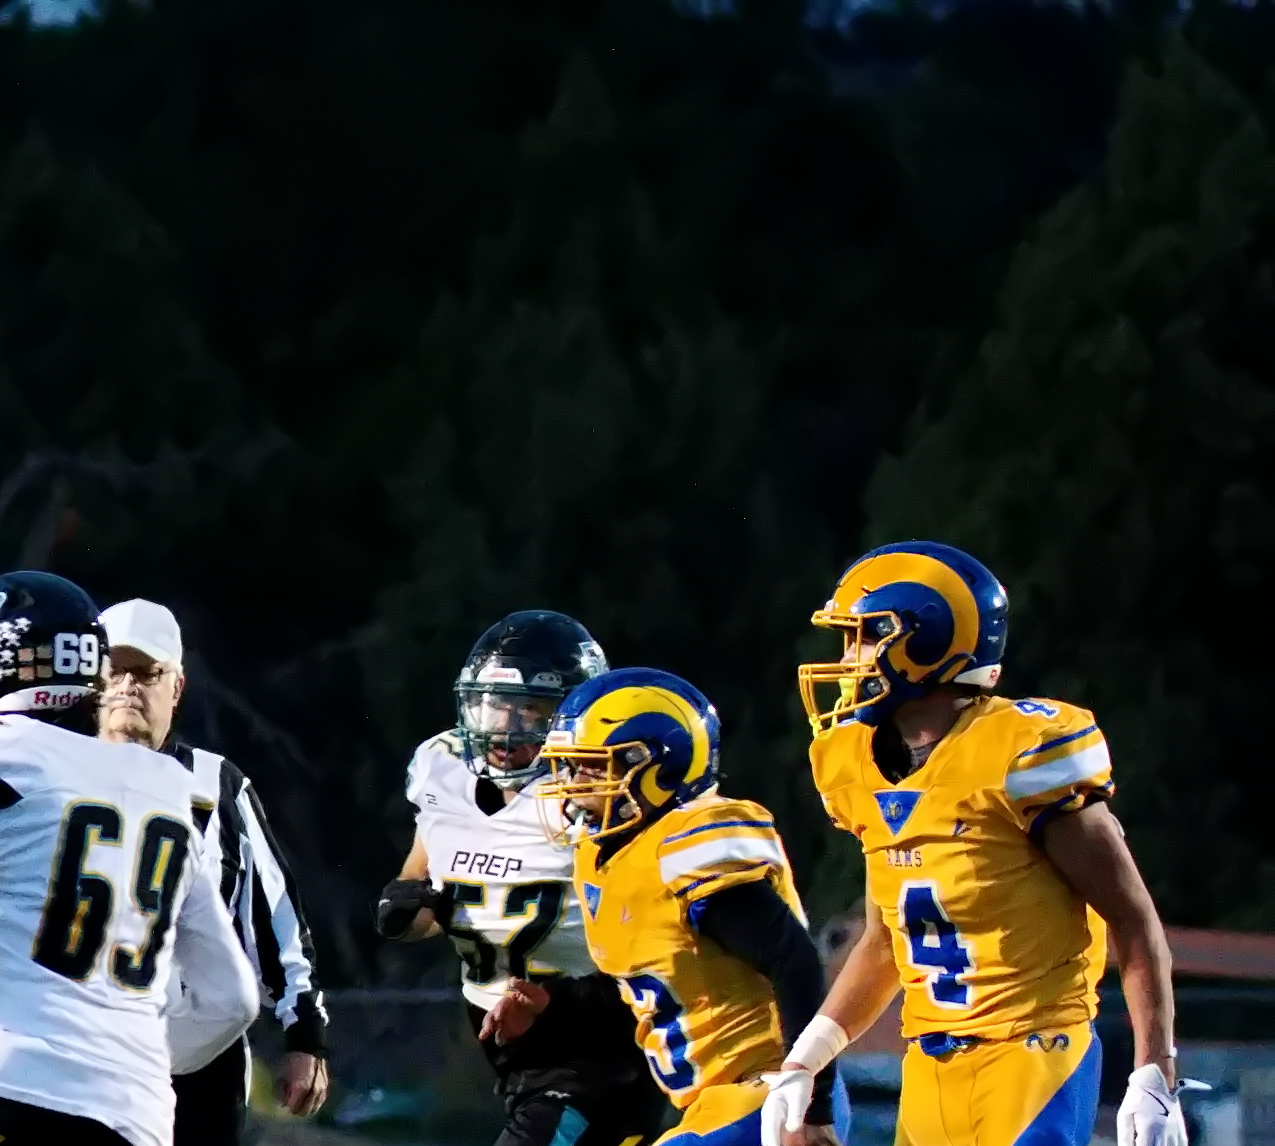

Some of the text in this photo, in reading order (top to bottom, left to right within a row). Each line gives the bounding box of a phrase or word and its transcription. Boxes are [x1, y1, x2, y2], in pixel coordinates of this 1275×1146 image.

[54, 632, 99, 676] 69
[34, 691, 82, 706] Ridd
[1012, 700, 1059, 718] 4
[31, 798, 192, 992] 69
[450, 850, 523, 878] PREP
[441, 878, 568, 988] 52
[898, 880, 976, 1010] 4
[618, 970, 700, 1096] 3
